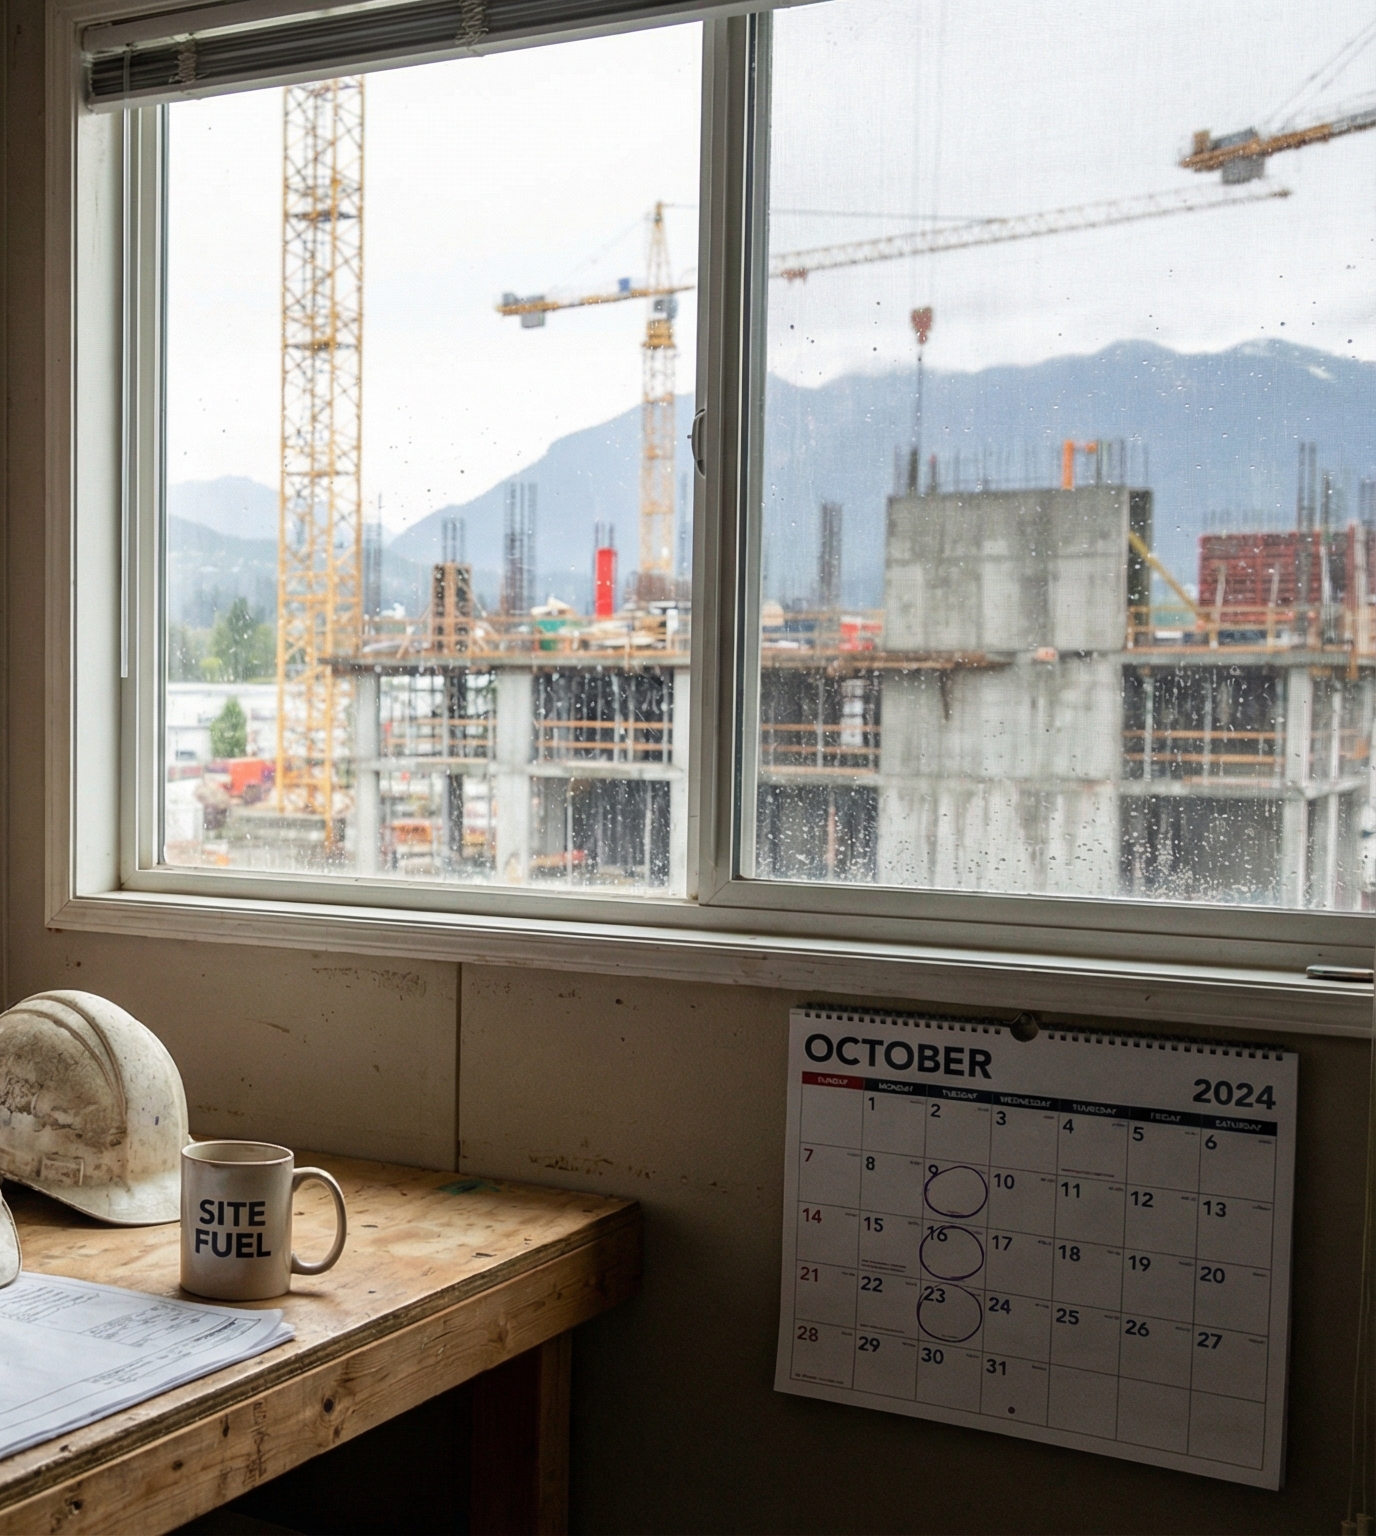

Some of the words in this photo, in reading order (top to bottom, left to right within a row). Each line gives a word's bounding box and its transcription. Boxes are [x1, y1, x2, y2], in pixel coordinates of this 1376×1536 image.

[804, 1032, 993, 1079] OCTOBER
[1192, 1078, 1277, 1110] 2024
[868, 1097, 875, 1110] 1
[930, 1103, 941, 1118] 2
[996, 1111, 1006, 1126] 3
[1063, 1118, 1074, 1134] 4
[1132, 1126, 1144, 1142] 5
[1205, 1134, 1217, 1150] 6
[803, 1149, 813, 1162] 7
[865, 1156, 875, 1171] 8
[928, 1164, 938, 1177] 9
[994, 1174, 1014, 1190] 10
[1061, 1183, 1081, 1198] 11
[1131, 1191, 1154, 1208] 12
[1202, 1200, 1226, 1218] 13
[199, 1199, 266, 1227] SITE
[195, 1228, 271, 1258] FUEL
[802, 1208, 822, 1224] 14
[864, 1216, 884, 1232] 15
[927, 1226, 948, 1242] 16
[991, 1235, 1012, 1251] 17
[1059, 1245, 1081, 1262] 18
[1128, 1255, 1151, 1272] 19
[1200, 1266, 1225, 1284] 20
[800, 1267, 819, 1282] 21
[861, 1276, 883, 1293] 22
[924, 1286, 945, 1303] 23
[989, 1297, 1011, 1314] 24
[1056, 1308, 1079, 1326] 25
[1125, 1320, 1149, 1338] 26
[1197, 1332, 1222, 1350] 27
[797, 1326, 819, 1342] 28
[858, 1336, 880, 1353] 29
[921, 1348, 944, 1365] 30
[986, 1359, 1007, 1375] 31
